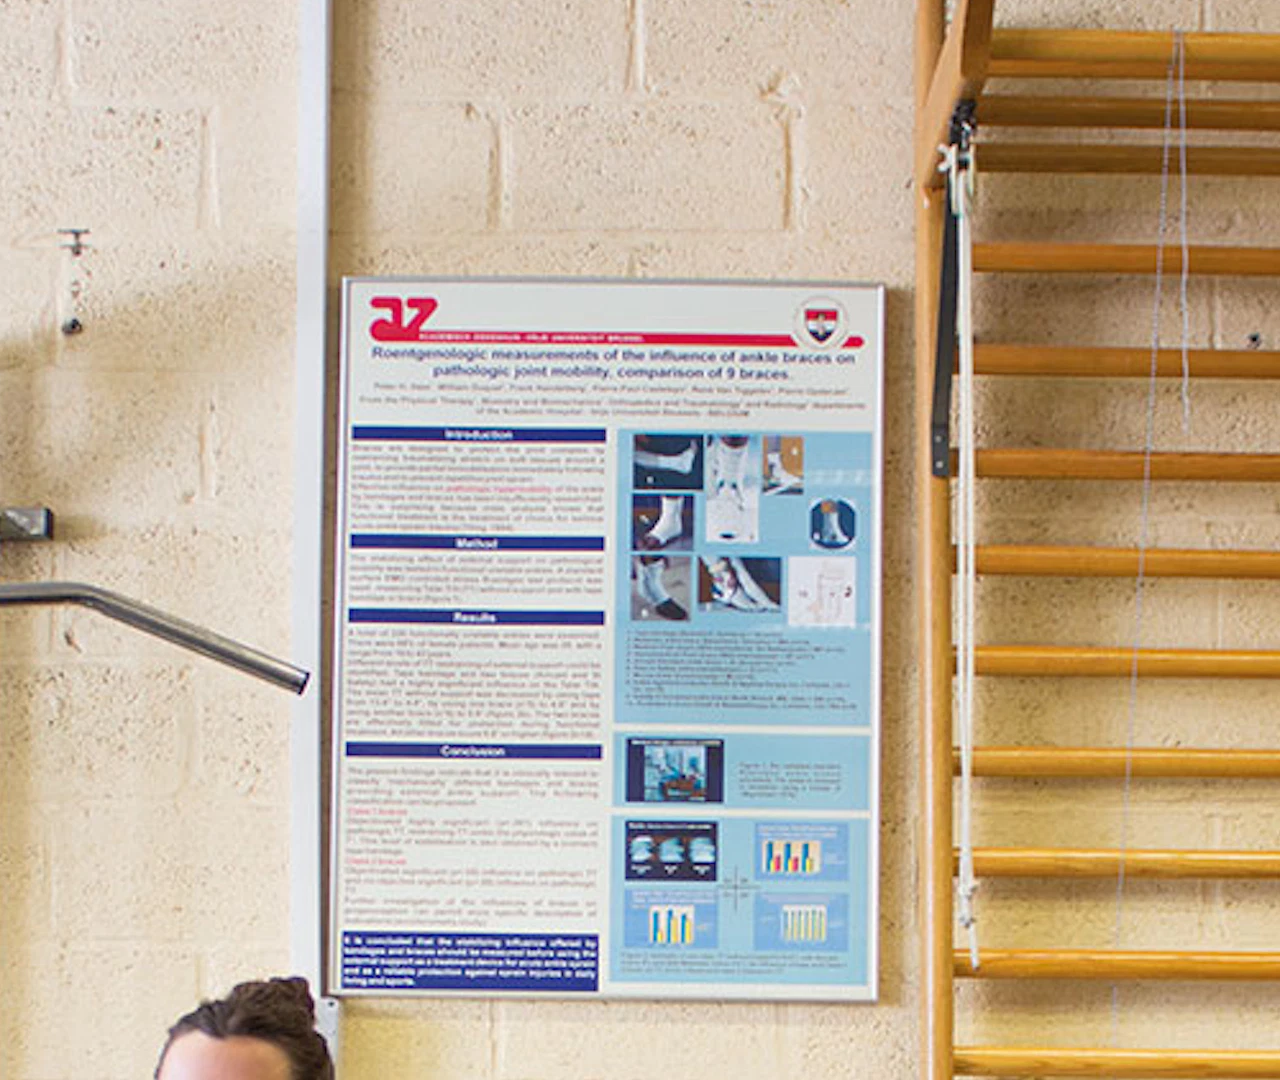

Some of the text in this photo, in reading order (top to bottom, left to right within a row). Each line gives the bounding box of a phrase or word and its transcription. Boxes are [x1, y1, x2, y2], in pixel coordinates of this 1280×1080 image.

[371, 347, 856, 364] Roentgenologic measurements of the influence of ankle braces on
[433, 365, 509, 378] pathologic
[513, 365, 547, 379] joint
[616, 368, 705, 380] comparison
[707, 367, 722, 379] of
[726, 367, 736, 379] 9
[443, 428, 514, 440] Introduction
[455, 538, 498, 549] Method
[452, 612, 497, 624] Results
[439, 744, 506, 757] Conclusion
